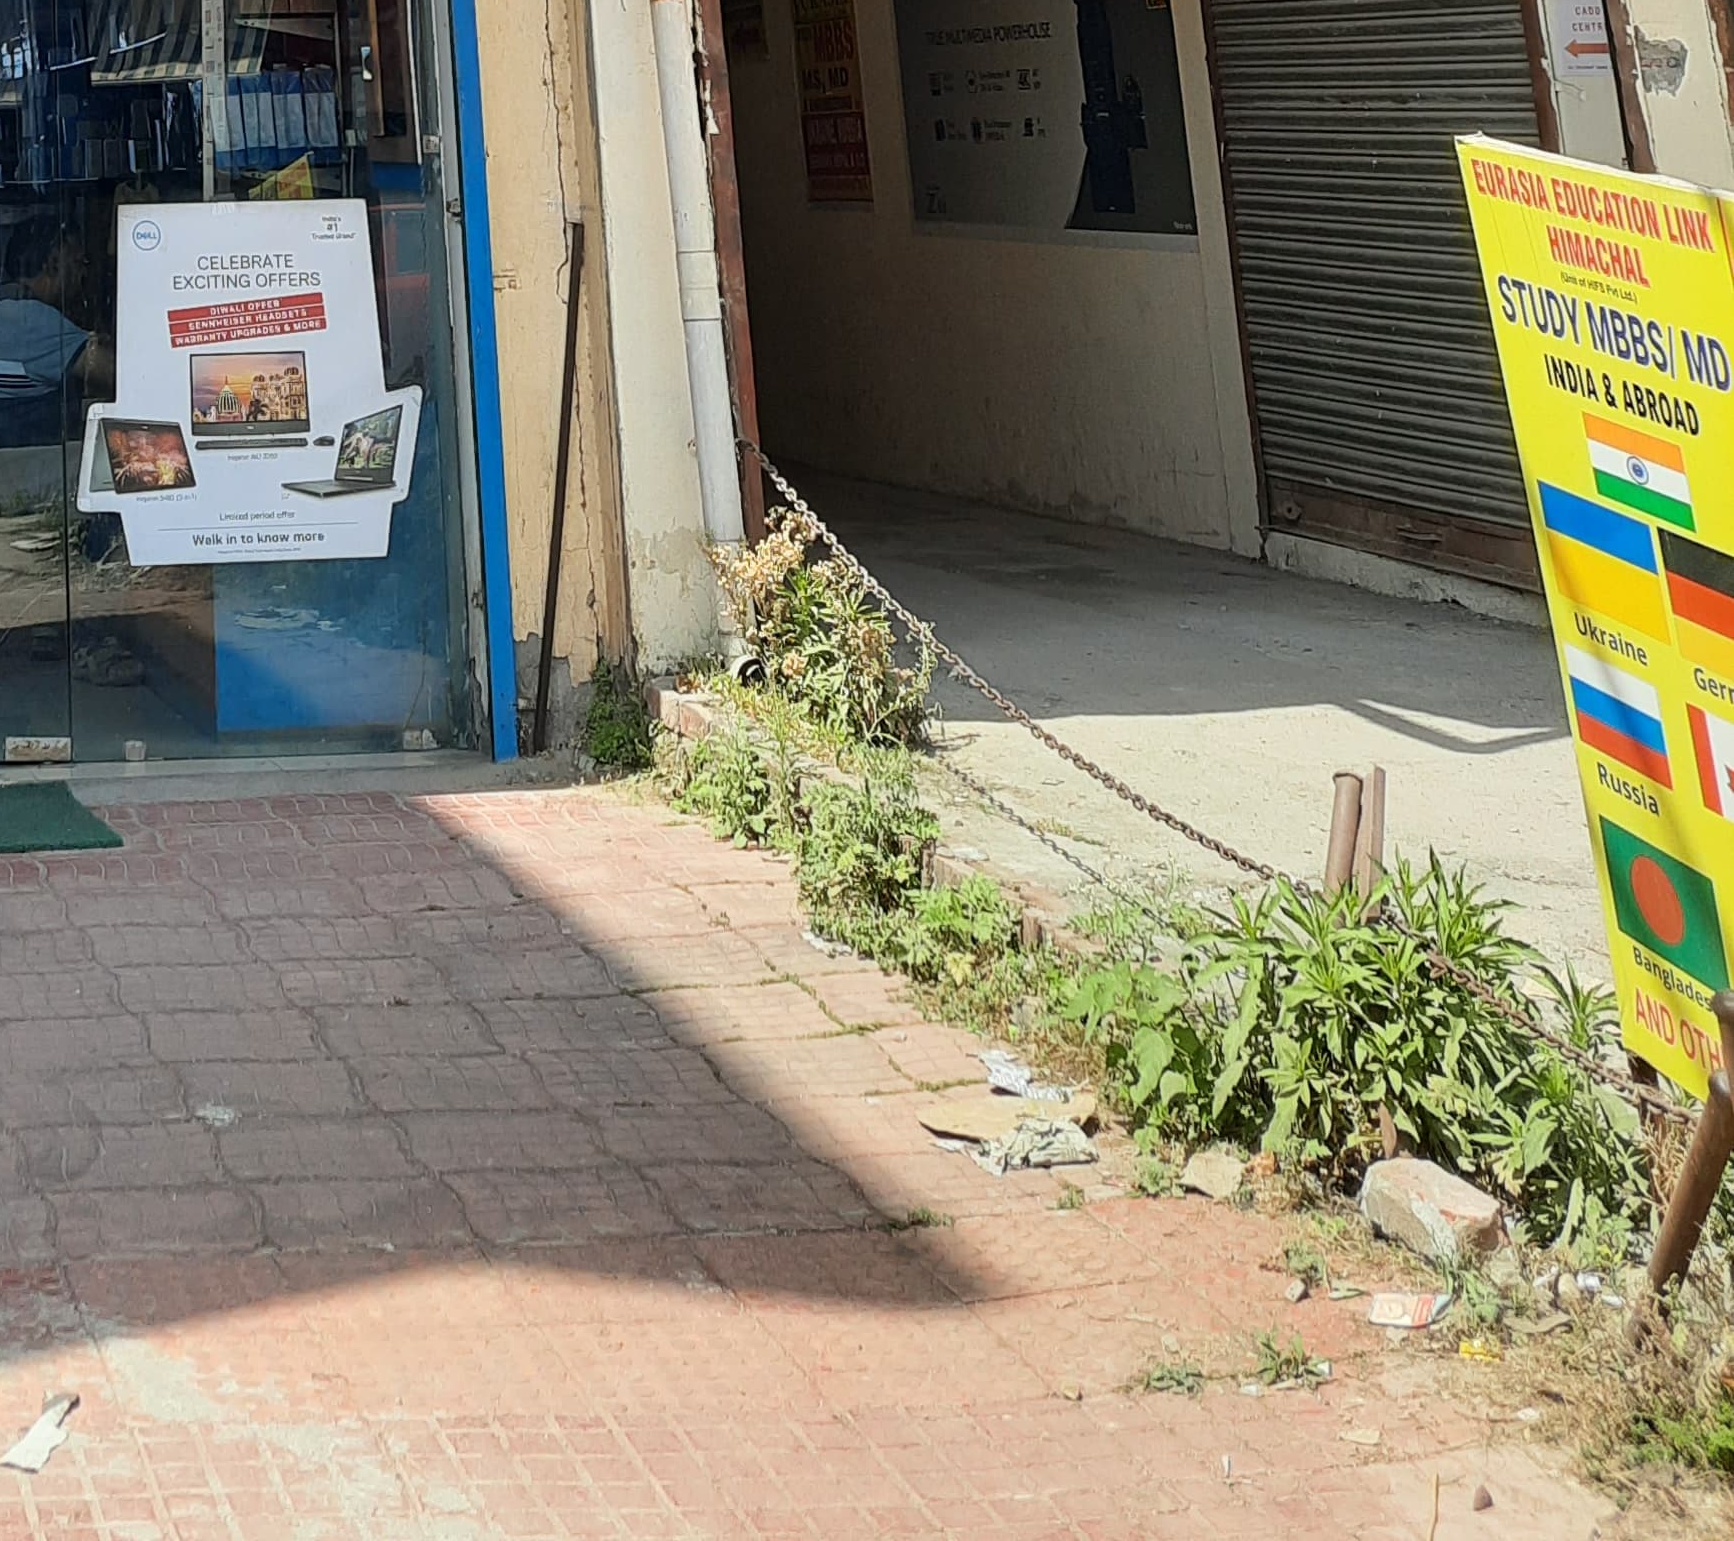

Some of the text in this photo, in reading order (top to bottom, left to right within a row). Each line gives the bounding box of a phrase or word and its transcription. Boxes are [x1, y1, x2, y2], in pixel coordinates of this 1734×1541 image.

[992, 21, 1052, 44] POWERHOUSE
[1470, 157, 1716, 255] EURASIA EDUCATION LINK
[197, 253, 294, 271] CELEBRATE
[1545, 223, 1652, 289] HIMACHAL
[172, 271, 322, 291] EXCITING OFFERS
[188, 308, 308, 332] SENNHEISER HEADSETS
[210, 303, 246, 316] DIWALI
[174, 320, 321, 346] WARRANTY UPGRADES & MORE
[1496, 273, 1732, 393] STUDY MBBS/ MD
[1543, 353, 1701, 438] INDIA & ABROAD
[250, 511, 275, 522] period
[276, 510, 296, 519] offer
[192, 532, 326, 547] Walk in to know more
[1573, 610, 1649, 667] Ukraine
[1596, 762, 1661, 818] Russia
[1632, 945, 1715, 1013] Banglades
[1635, 987, 1676, 1047] AND
